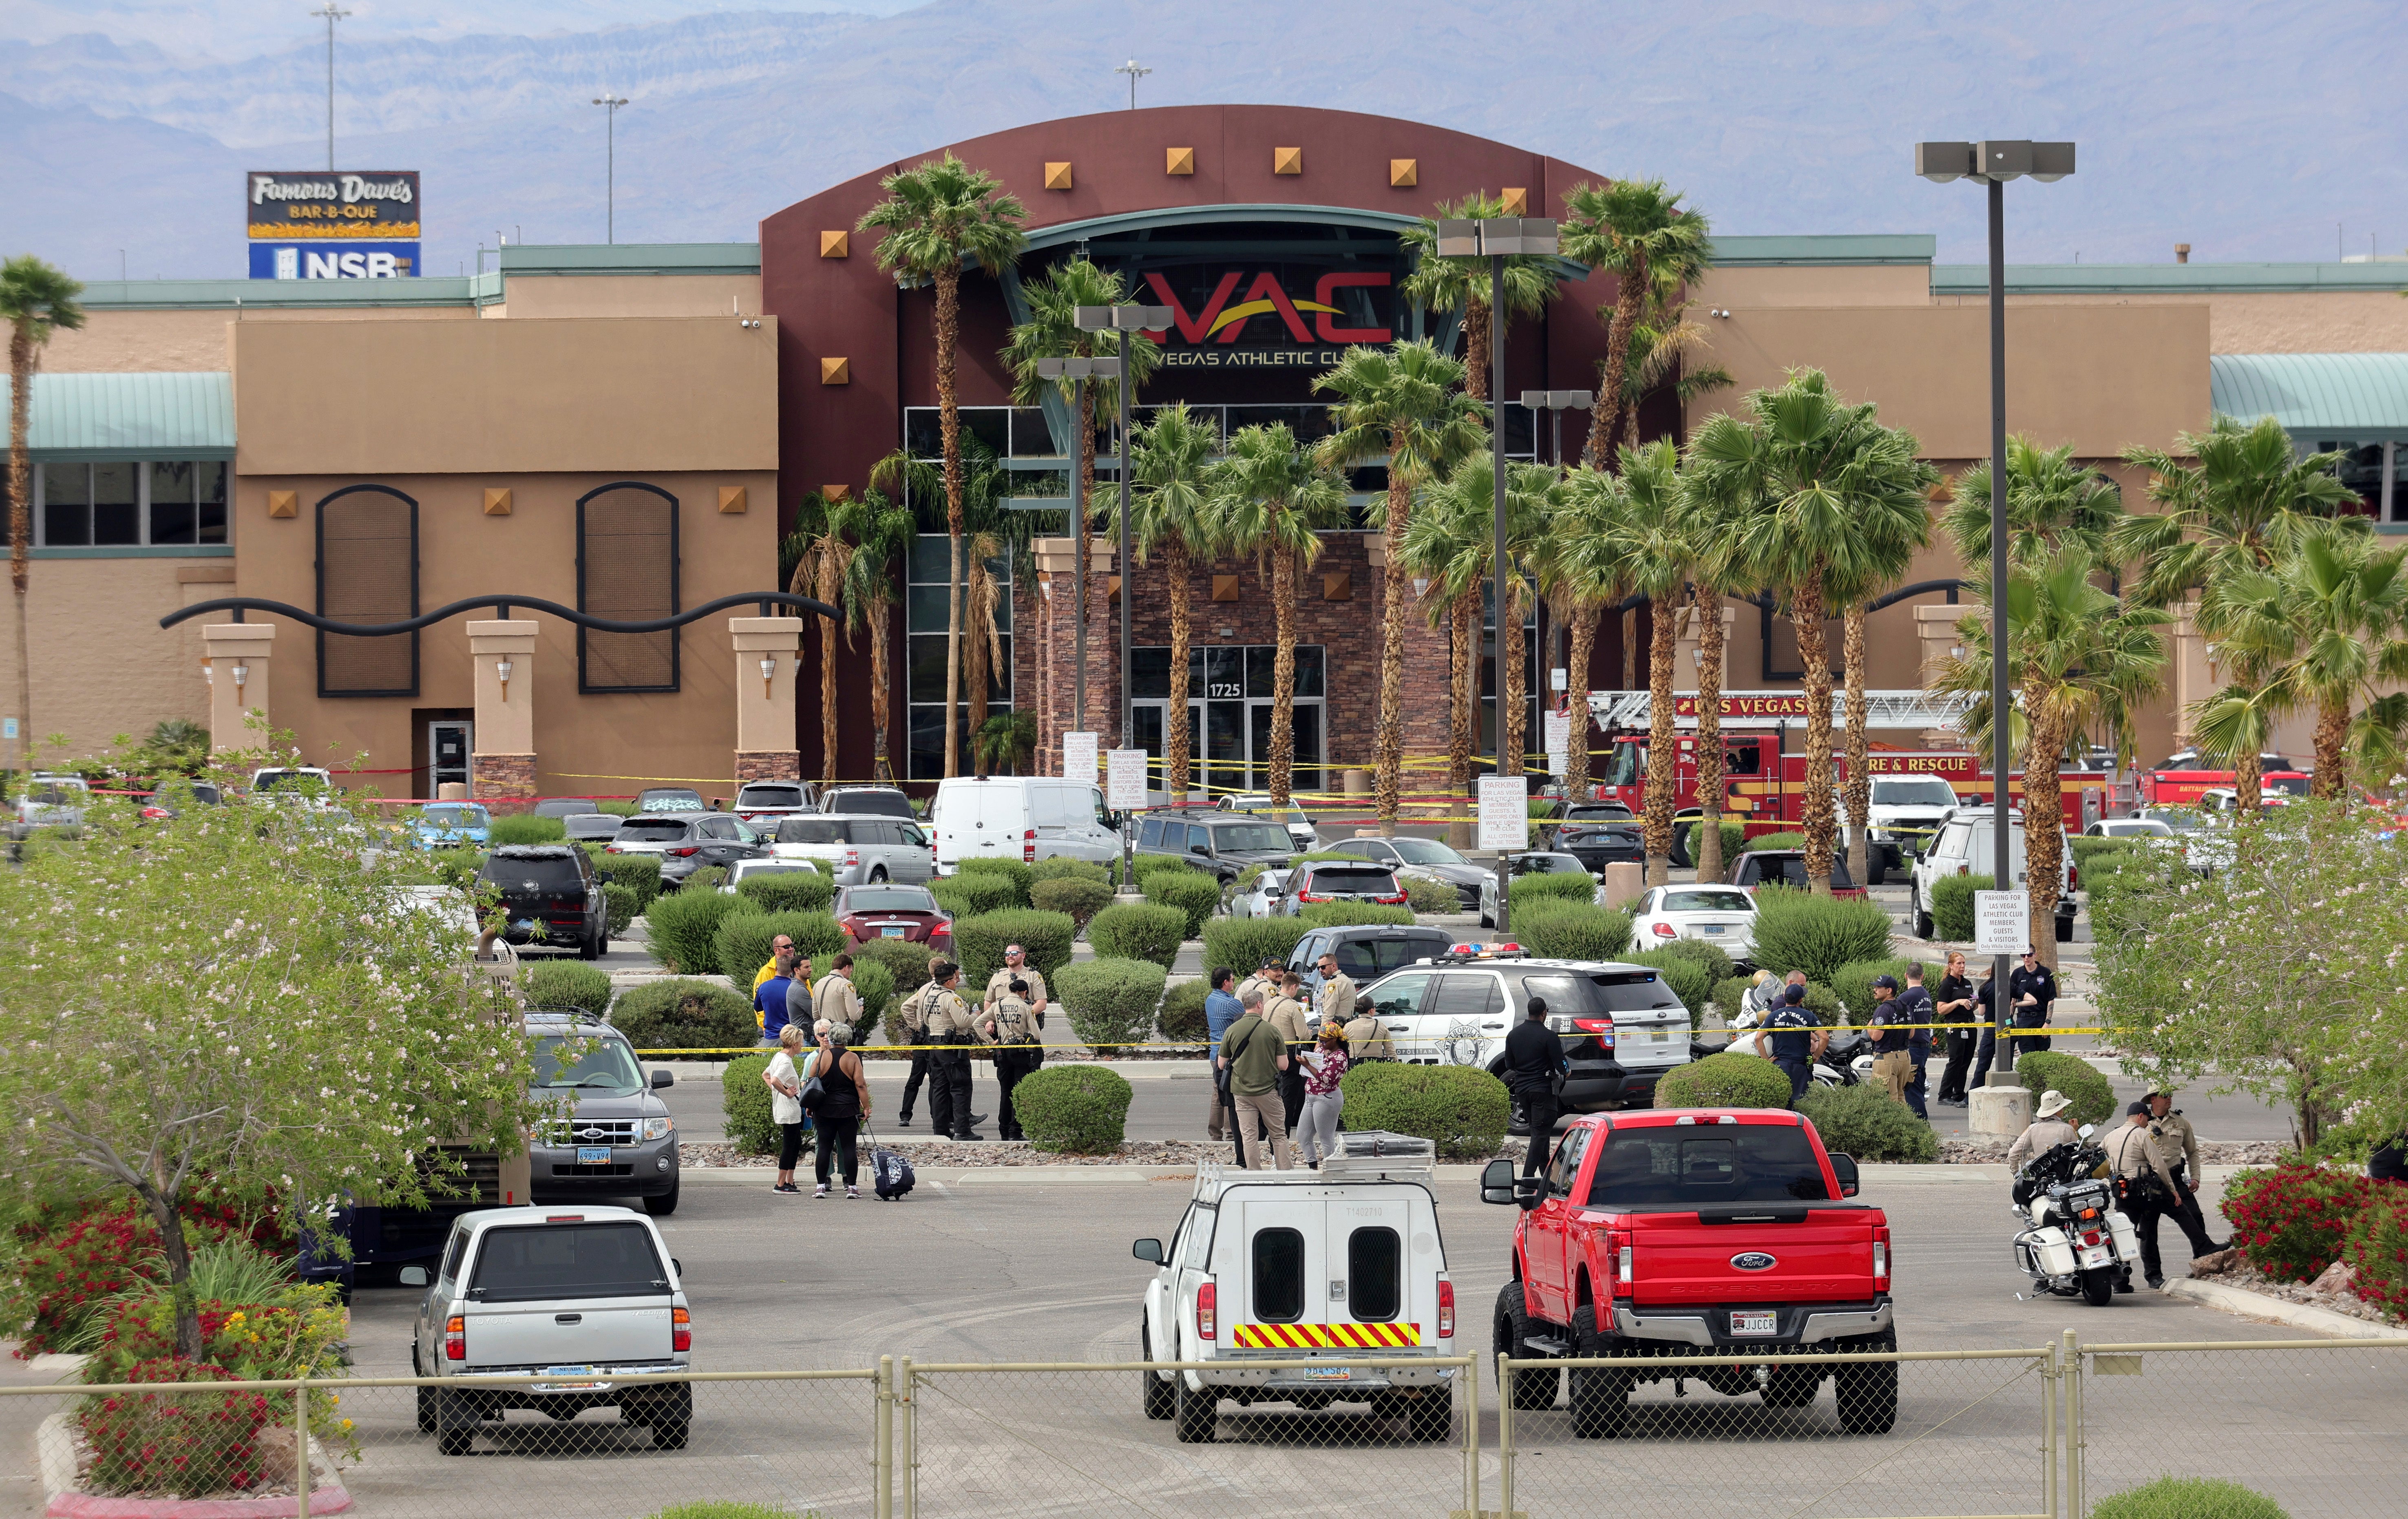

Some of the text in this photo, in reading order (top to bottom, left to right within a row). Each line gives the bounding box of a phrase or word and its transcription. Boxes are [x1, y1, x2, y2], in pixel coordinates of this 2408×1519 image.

[252, 175, 413, 205] Famous Dave's
[289, 205, 378, 219] BAR-B-QUE
[1142, 272, 1391, 344] VAC
[1225, 351, 1313, 365] ATHLETIC
[1210, 683, 1240, 697] 1725
[1693, 699, 1806, 714] LS VEGAS
[1869, 758, 1968, 771] RE & RESCUE
[1000, 1004, 1018, 1013] METRO
[996, 1013, 1024, 1024] POLICE
[1774, 1011, 1786, 1022] LAS
[2069, 1185, 2100, 1195] POLICE
[1346, 1207, 1382, 1216] T1402710
[1741, 1256, 1765, 1267] Ford
[1670, 1282, 1838, 1293] SUPER DUTY
[470, 1317, 512, 1325] TOYOTA
[1746, 1319, 1774, 1330] JJCCR
